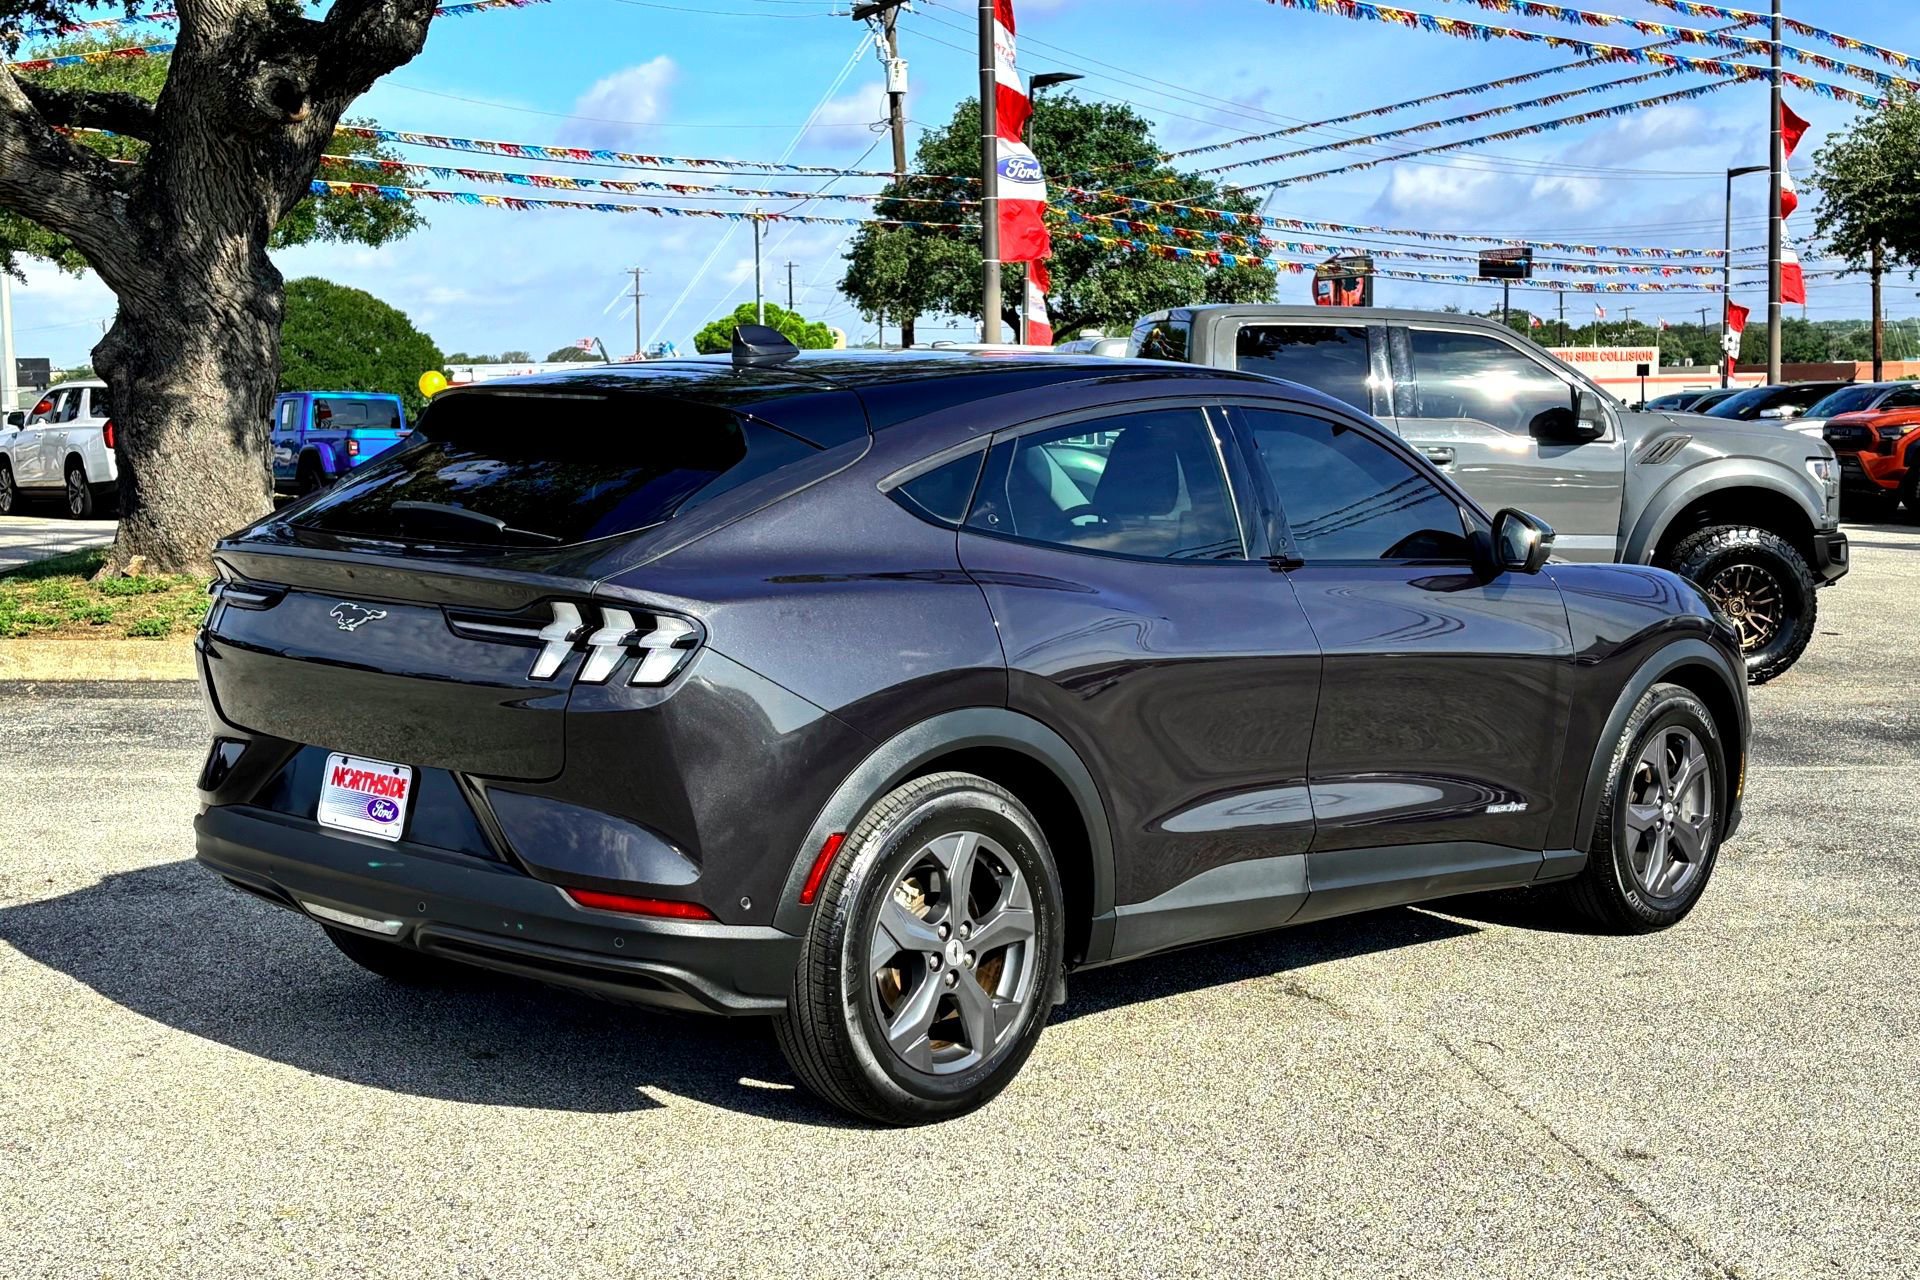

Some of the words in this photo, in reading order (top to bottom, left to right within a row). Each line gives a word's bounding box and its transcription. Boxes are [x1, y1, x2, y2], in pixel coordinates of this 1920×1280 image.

[1005, 158, 1041, 179] Ford
[1575, 351, 1599, 362] SIDE
[1600, 351, 1654, 362] COLLISION
[331, 766, 408, 799] NORTHSIDE
[372, 800, 395, 820] Ford
